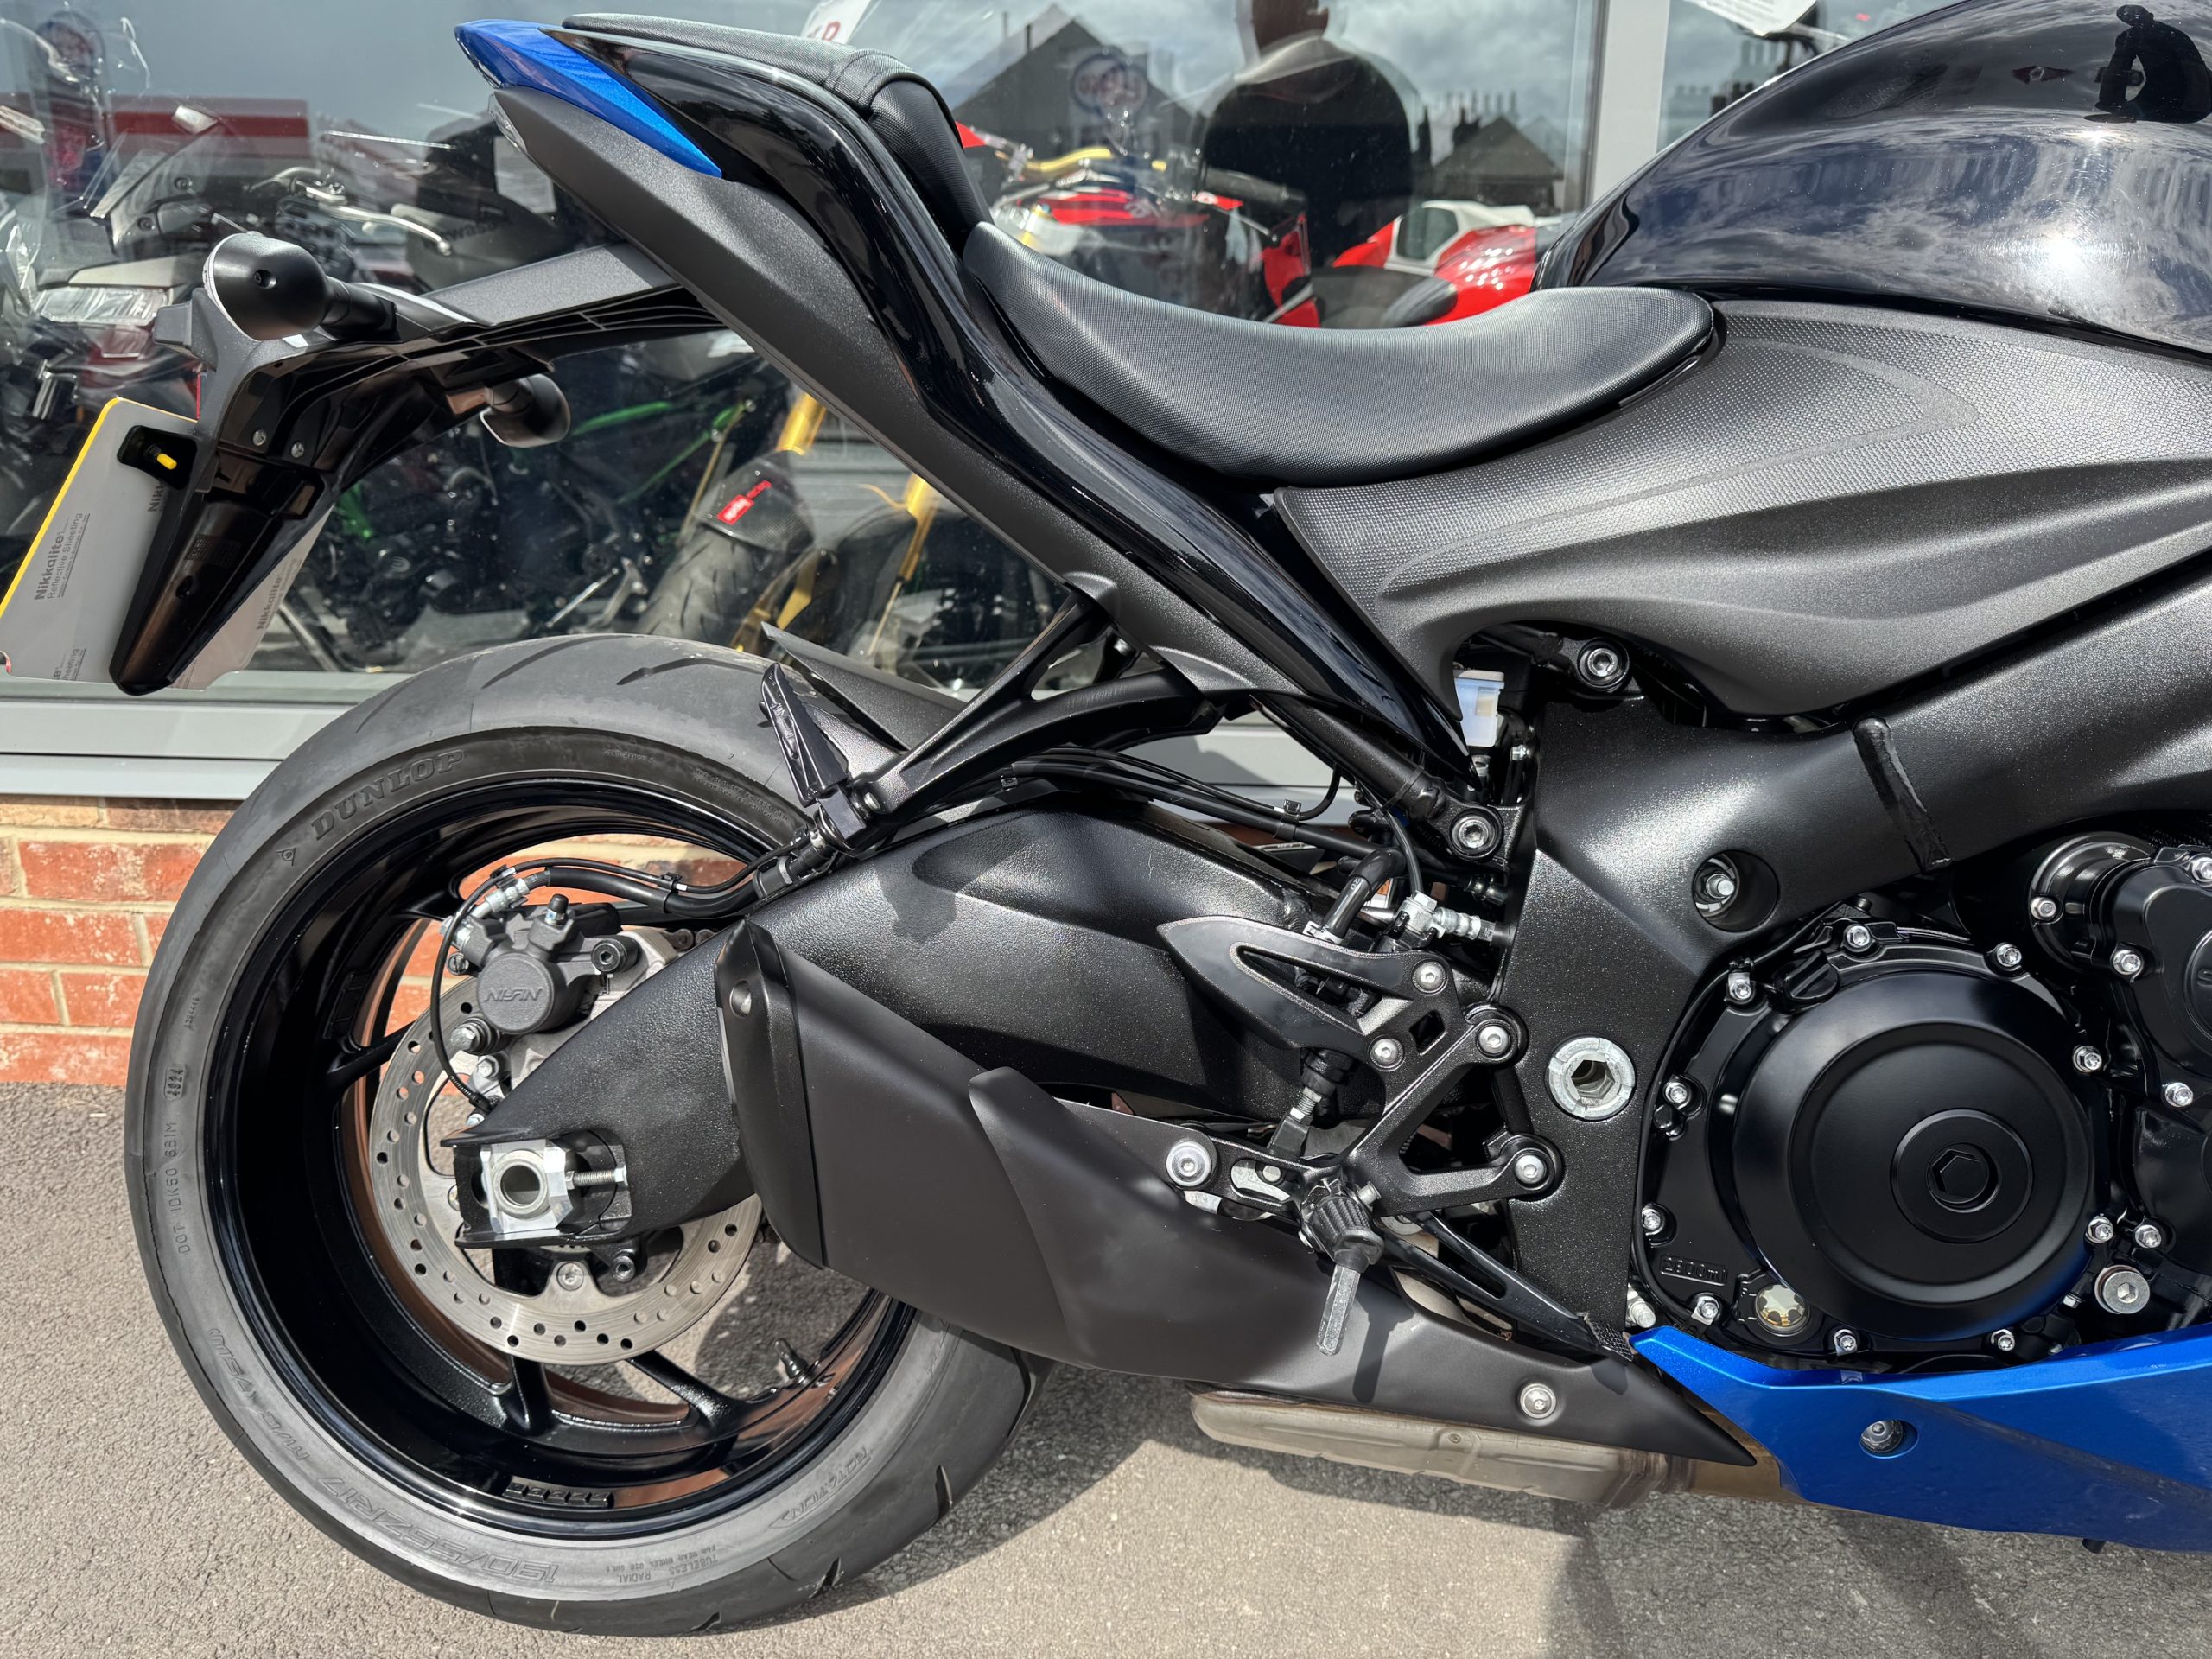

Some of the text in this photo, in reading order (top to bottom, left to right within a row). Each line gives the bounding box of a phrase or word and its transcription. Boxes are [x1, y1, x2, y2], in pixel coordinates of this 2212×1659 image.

[35, 533, 64, 600] Nikkalite
[48, 512, 83, 599] Reflective Sheeting
[312, 748, 465, 841] DUNLOP
[484, 987, 543, 1002] NISSIN
[174, 1225, 190, 1253] DOT
[786, 1446, 871, 1520] ROTATION
[617, 1555, 718, 1583] TUBELESS RADIAL
